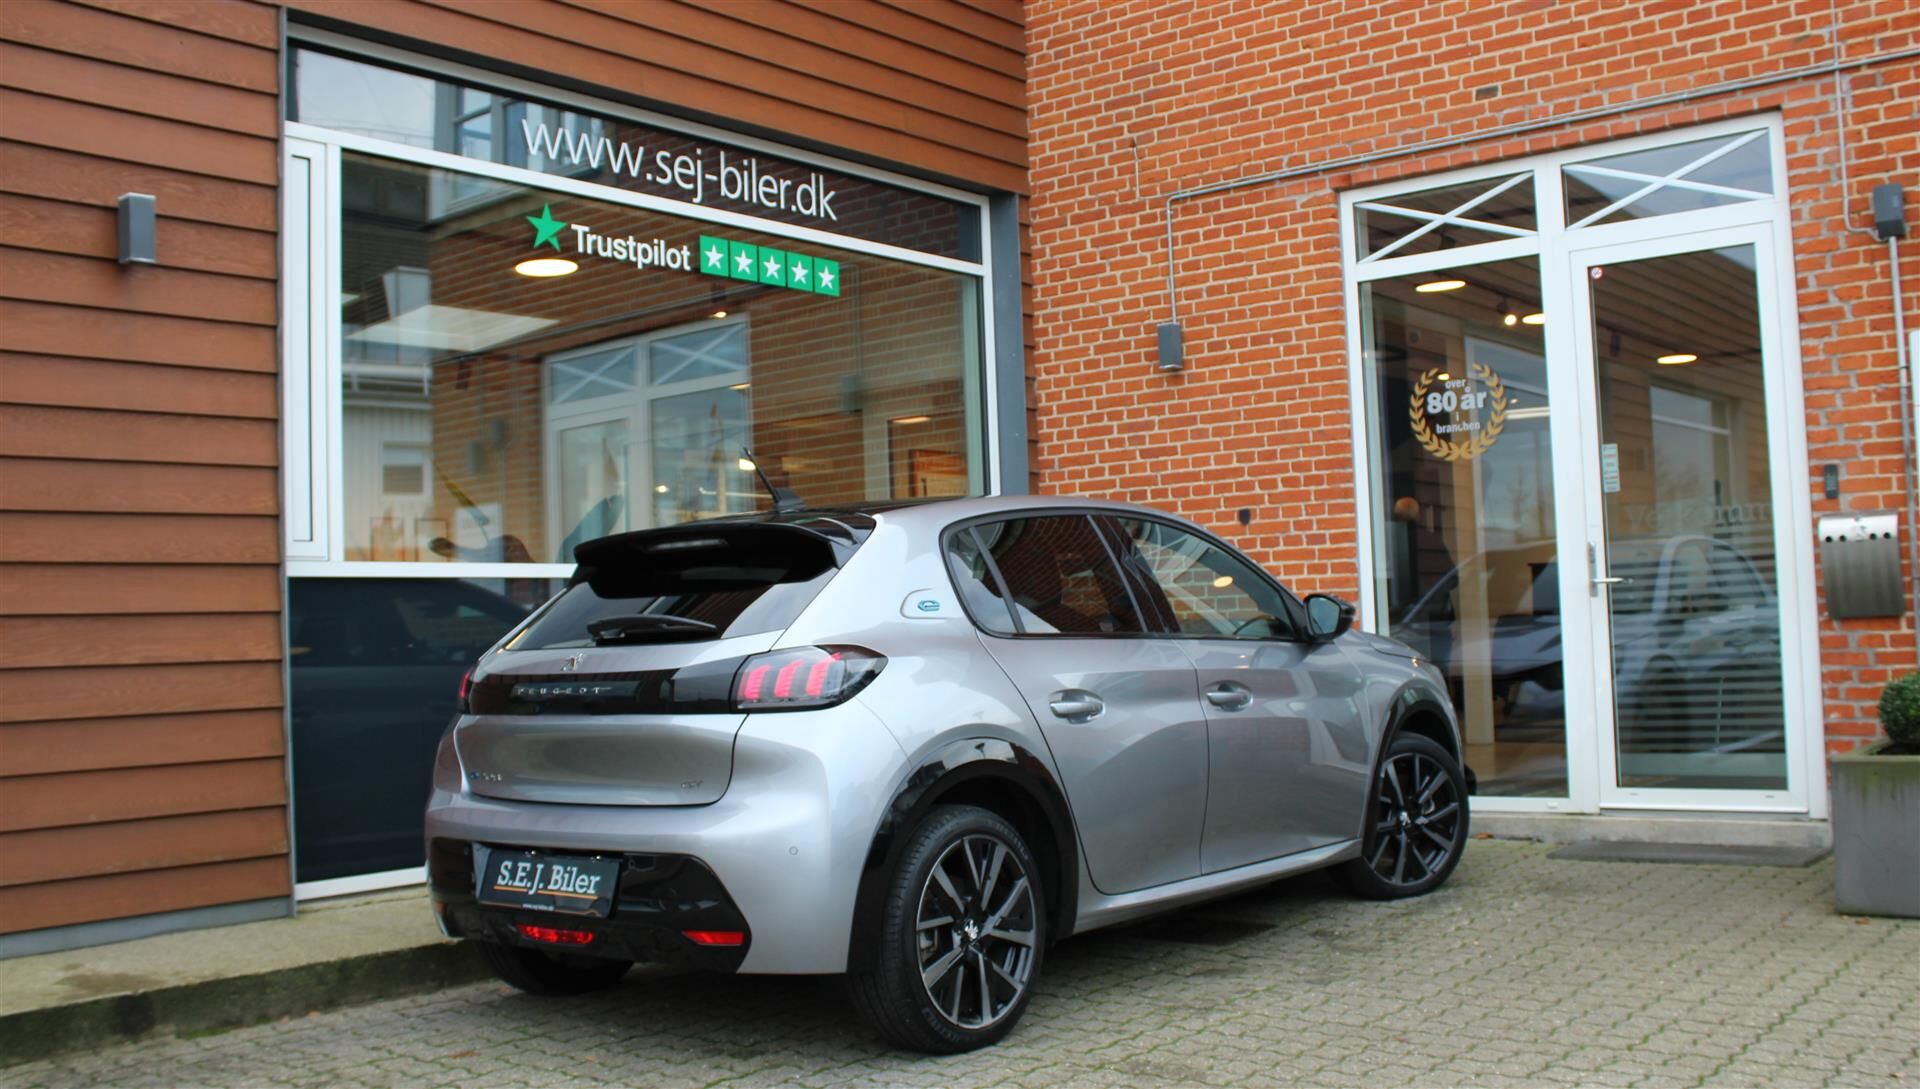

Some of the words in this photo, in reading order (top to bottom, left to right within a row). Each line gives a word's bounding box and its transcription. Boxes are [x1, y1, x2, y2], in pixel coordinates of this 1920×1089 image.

[521, 118, 838, 221] www.sej-biler.dk
[570, 223, 691, 272] Trustpilot
[1426, 391, 1458, 414] 80
[1460, 386, 1488, 410] år
[1444, 379, 1466, 390] over
[517, 687, 604, 696] PEUGEOT
[496, 860, 545, 895] S.E.J.
[547, 864, 601, 894] Biler
